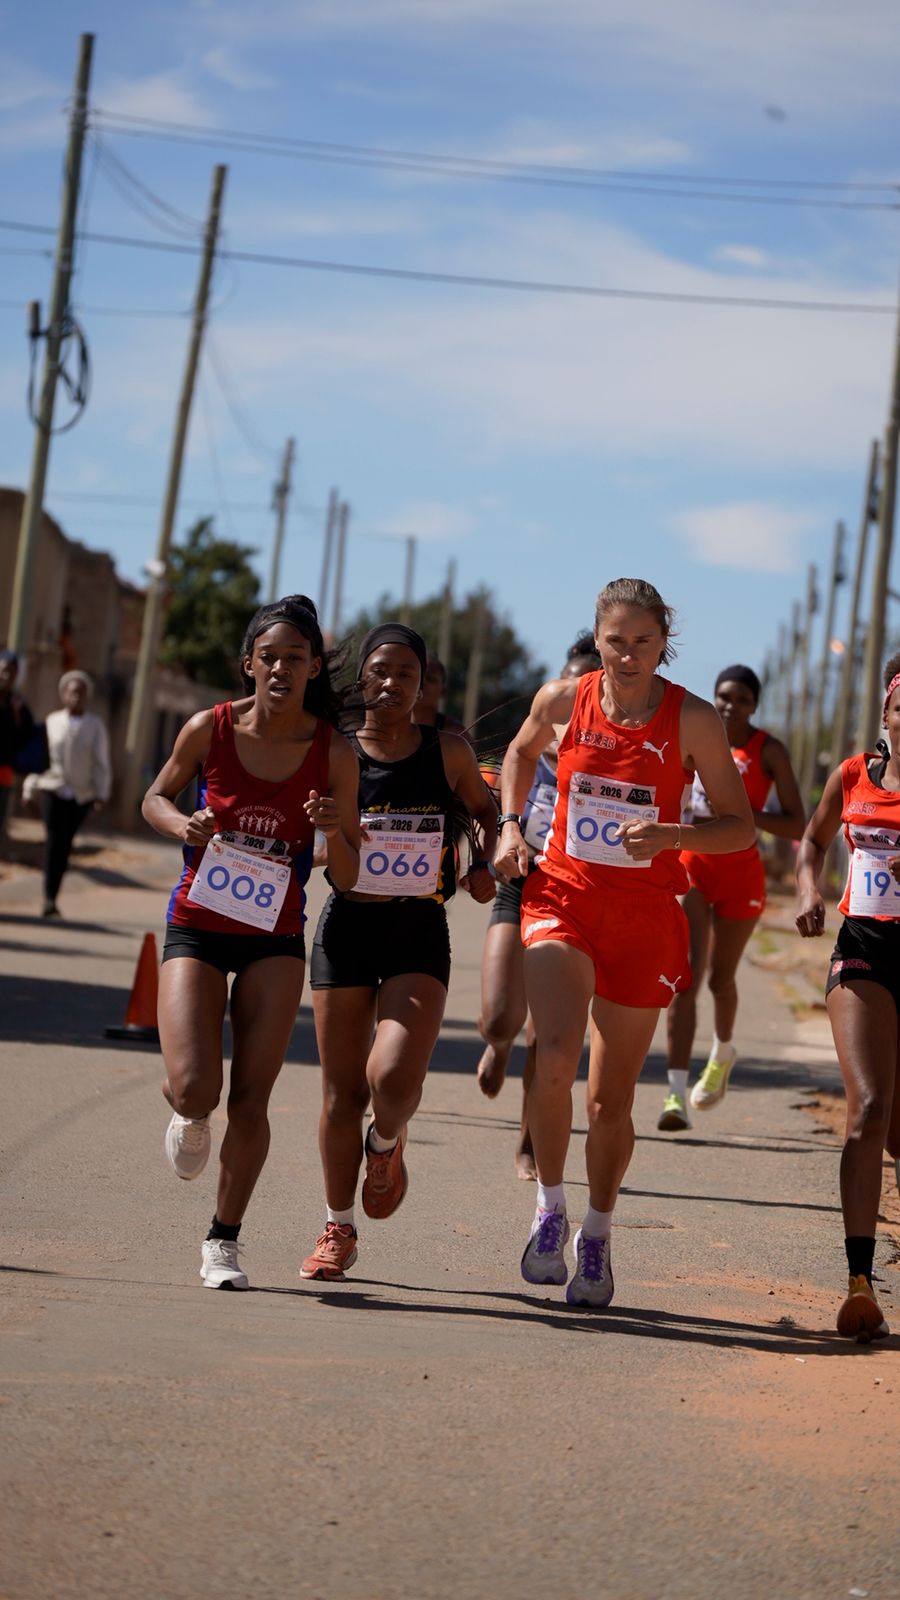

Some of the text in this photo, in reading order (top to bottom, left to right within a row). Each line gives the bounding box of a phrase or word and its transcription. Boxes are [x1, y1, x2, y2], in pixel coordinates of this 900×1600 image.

[600, 785, 622, 798] 2026
[630, 790, 650, 801] ASA
[596, 809, 627, 821] STREET MILE
[390, 819, 413, 832] 2026
[420, 820, 440, 829] ASA
[576, 817, 624, 847] 00
[242, 835, 265, 850] 2026
[384, 842, 415, 851] STREET MILE
[232, 861, 263, 877] STREET MILE
[366, 851, 430, 878] 066
[207, 865, 276, 908] 008
